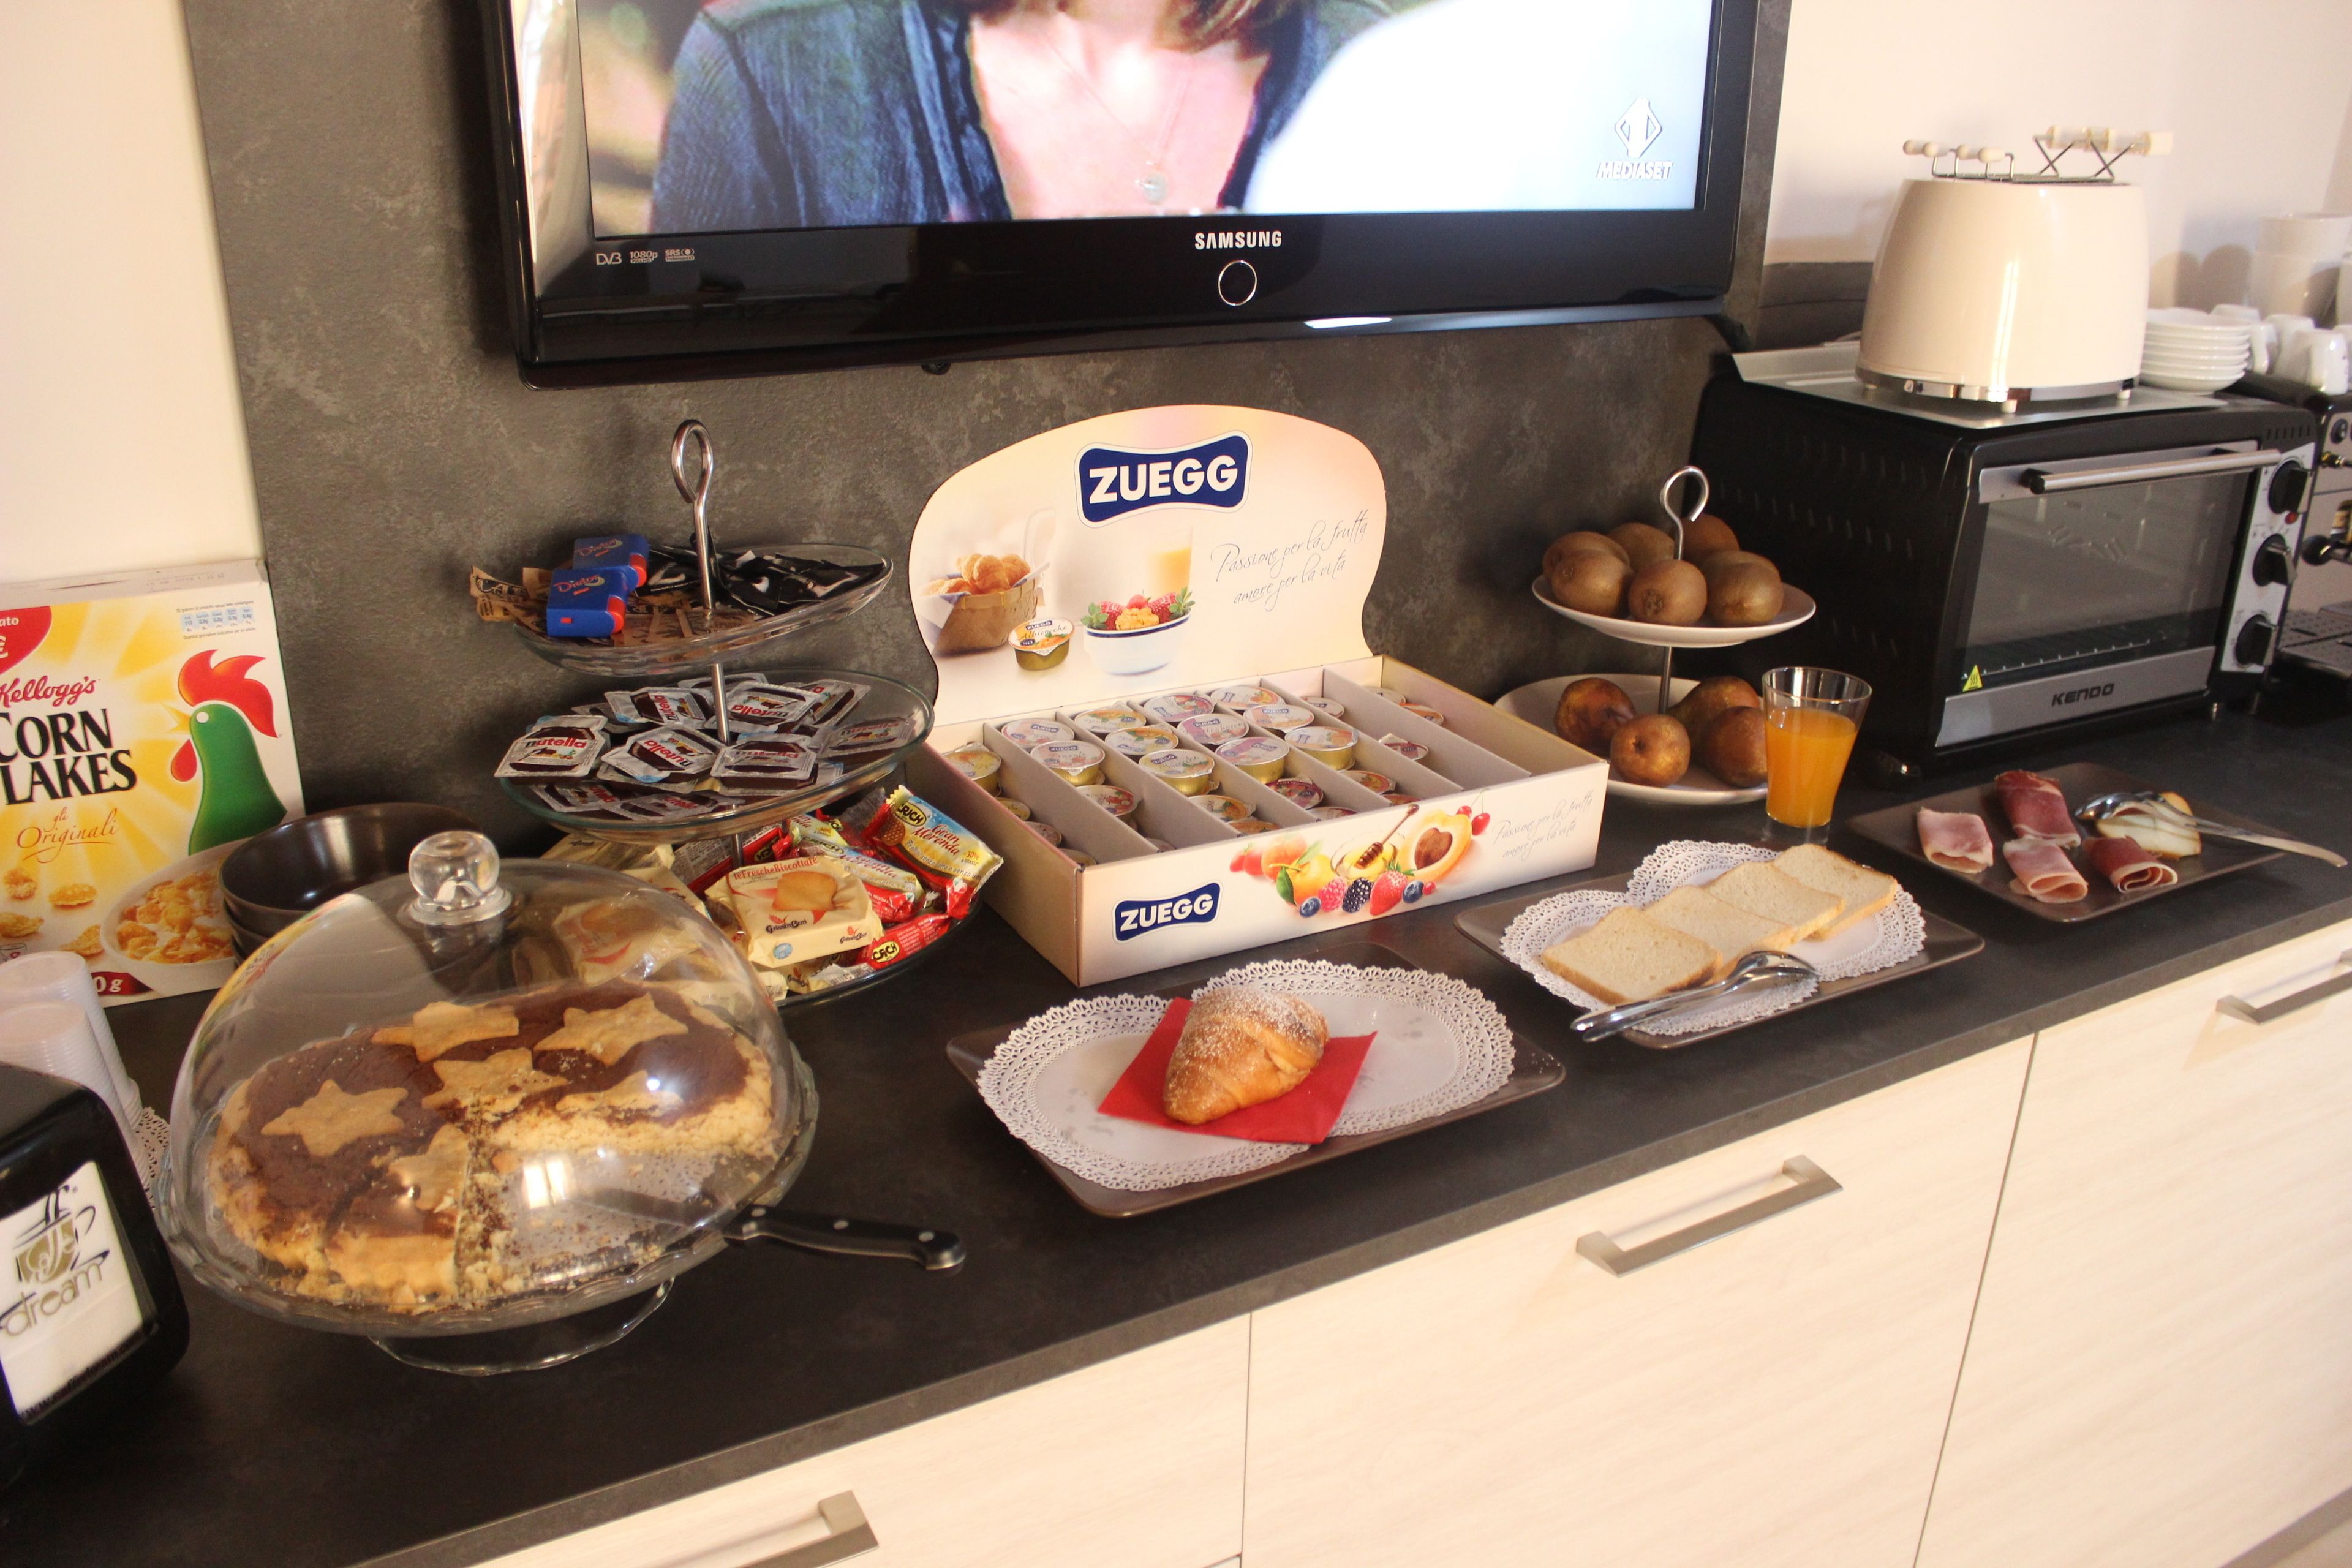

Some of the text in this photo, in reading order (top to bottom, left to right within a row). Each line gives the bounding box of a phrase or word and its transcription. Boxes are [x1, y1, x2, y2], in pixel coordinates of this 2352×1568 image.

[1596, 160, 1675, 181] MEDIASET
[1194, 230, 1283, 250] SAMSUNG
[629, 249, 658, 262] 1080p
[1088, 454, 1238, 505] ZUEGG
[1210, 509, 1369, 582] Passione per la frutta
[1233, 549, 1347, 612] amore per la vita
[0, 616, 19, 627] ato
[0, 675, 97, 708] Kellogg's
[2052, 683, 2114, 707] KENDO
[731, 704, 789, 718] nutella
[525, 737, 587, 748] nutella
[644, 739, 693, 767] nutella
[0, 749, 137, 805] LAKES
[17, 808, 118, 864] Originali
[911, 827, 960, 856] Merenda
[932, 824, 960, 843] Gran
[1120, 893, 1214, 932] ZUEGG
[2, 1262, 103, 1338] dream
